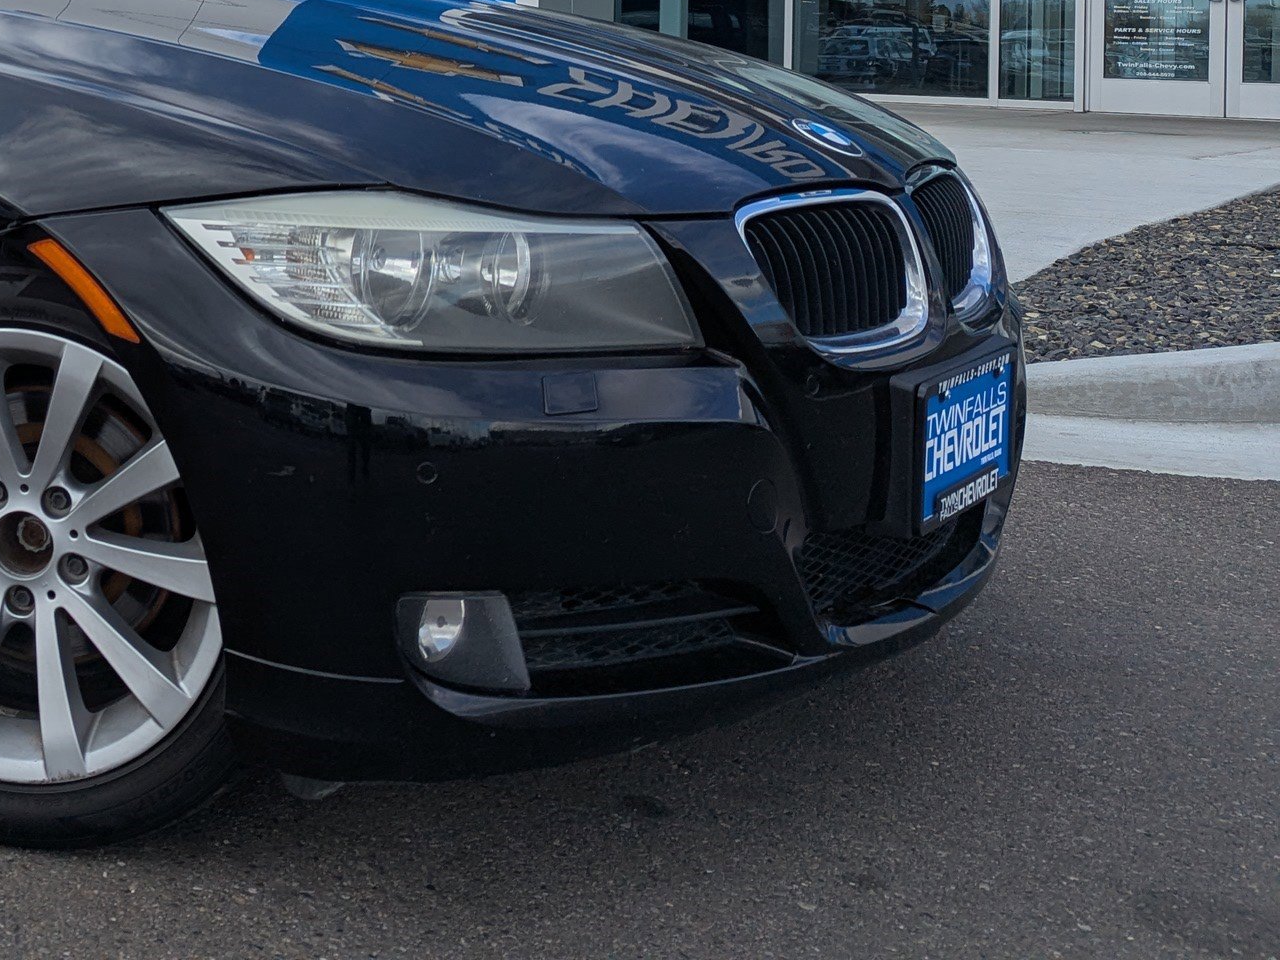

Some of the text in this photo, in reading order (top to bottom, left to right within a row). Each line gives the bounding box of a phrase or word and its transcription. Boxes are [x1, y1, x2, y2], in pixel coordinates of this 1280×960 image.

[1116, 61, 1196, 70] TwinFalls-Chevy.com
[927, 381, 1007, 439] TWINFALLS
[924, 404, 1006, 483] CHEVROLET
[940, 489, 959, 512] TWIN
[958, 467, 1000, 511] CHEVROLET
[939, 502, 959, 522] FALLS
